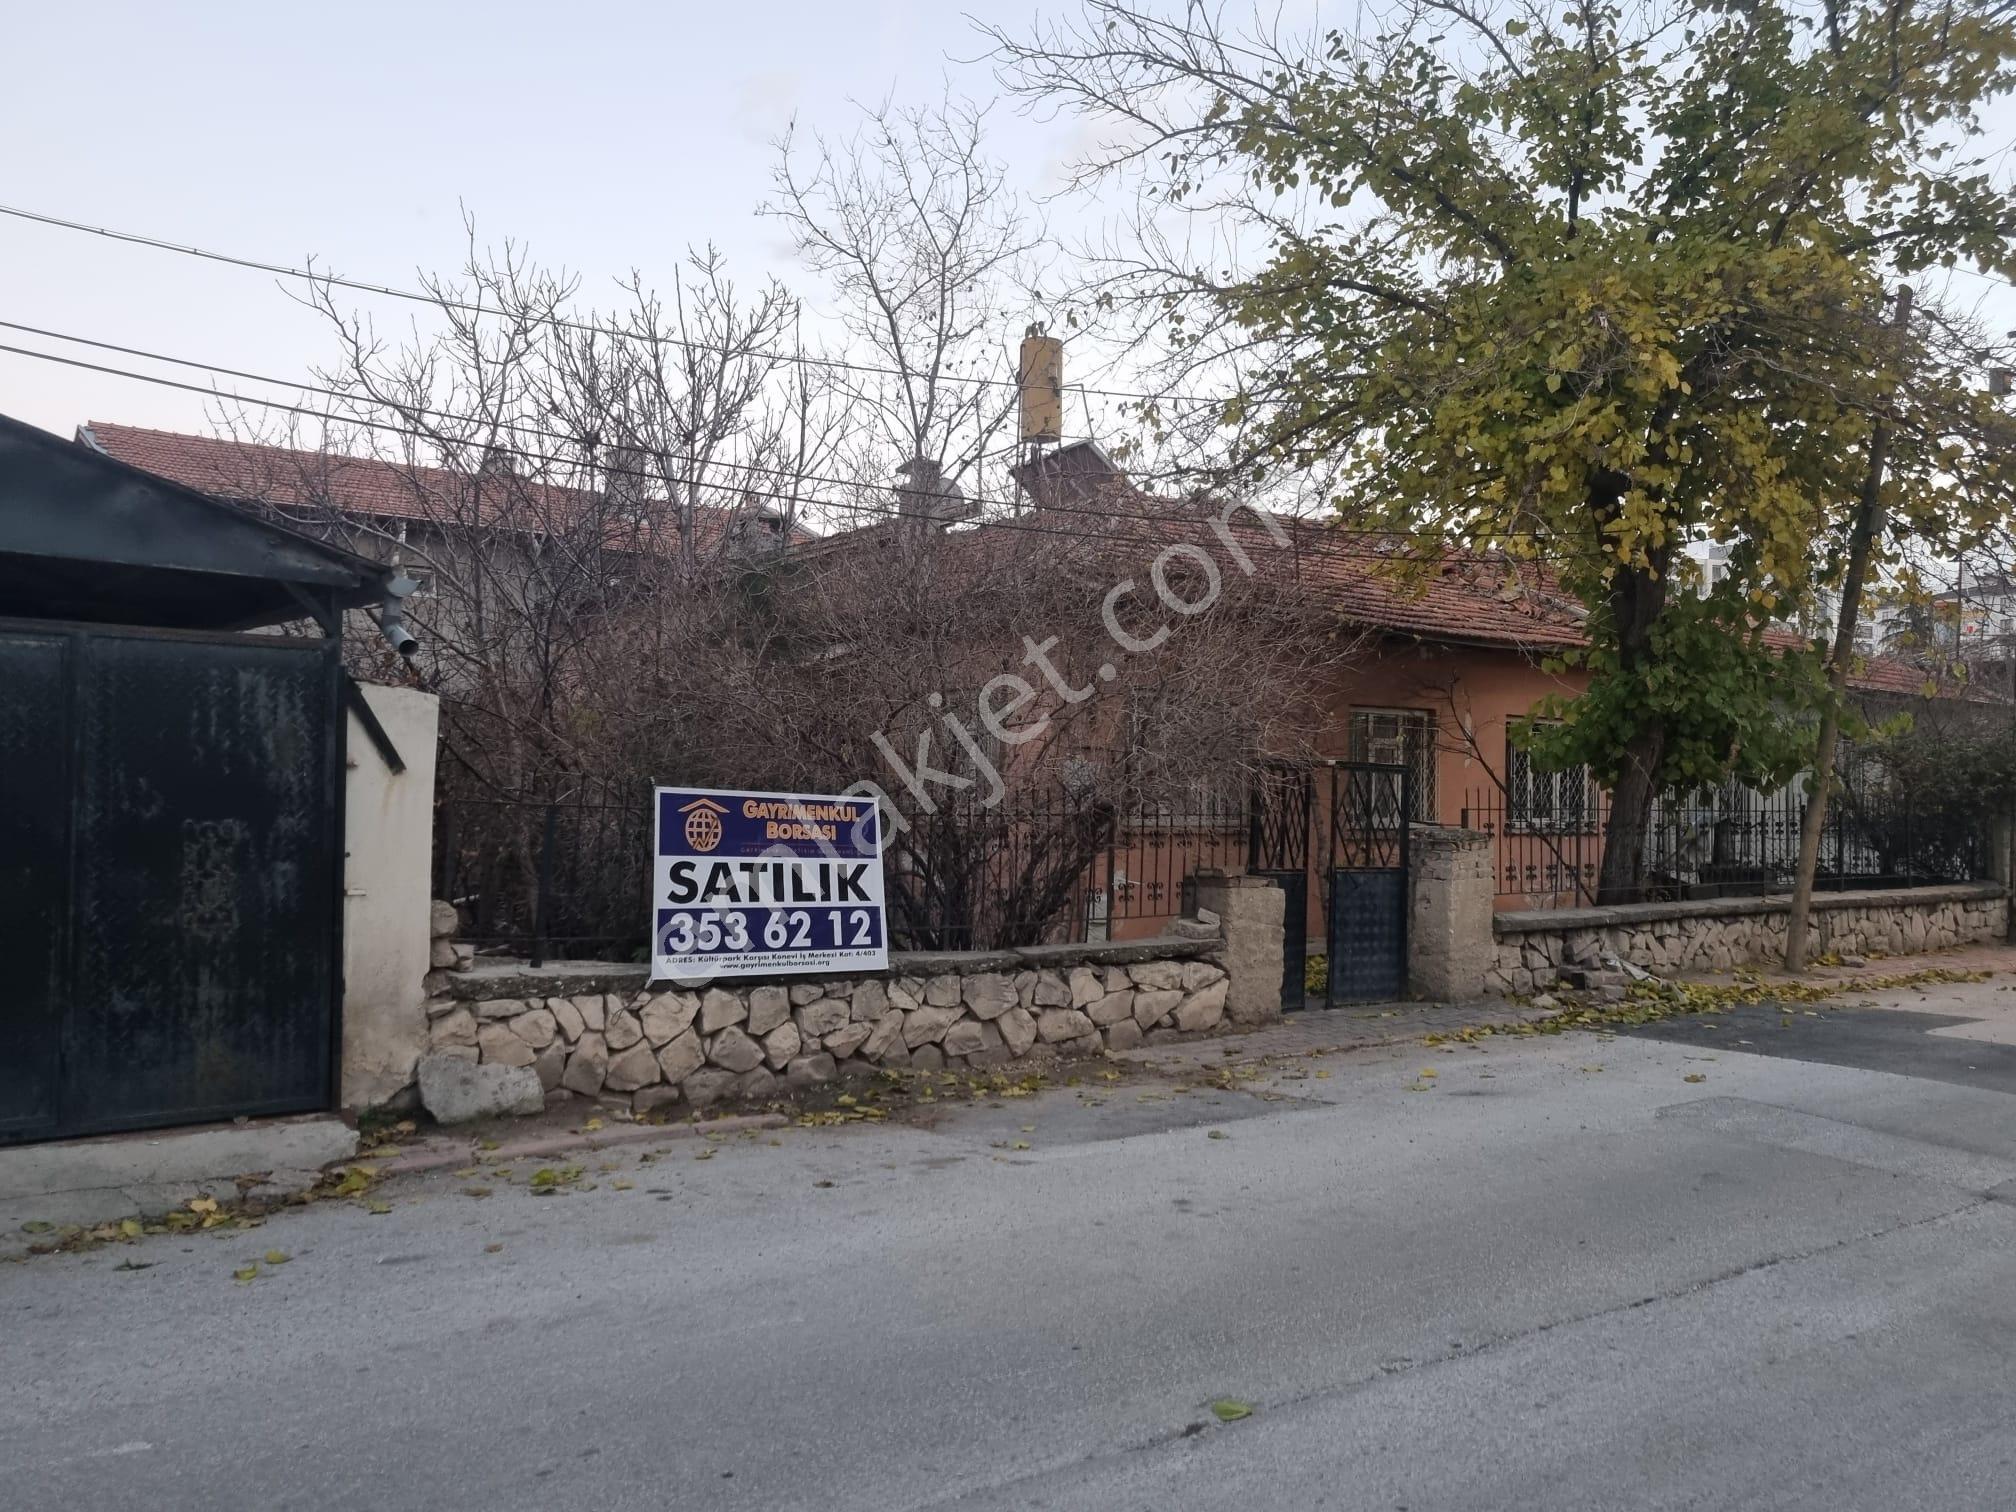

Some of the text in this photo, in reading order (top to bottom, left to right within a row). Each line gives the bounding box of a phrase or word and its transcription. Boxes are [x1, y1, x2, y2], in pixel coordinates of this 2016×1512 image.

[766, 821, 837, 841] BORSASI
[667, 860, 872, 904] SATILIK
[668, 909, 872, 951] 353 62 12
